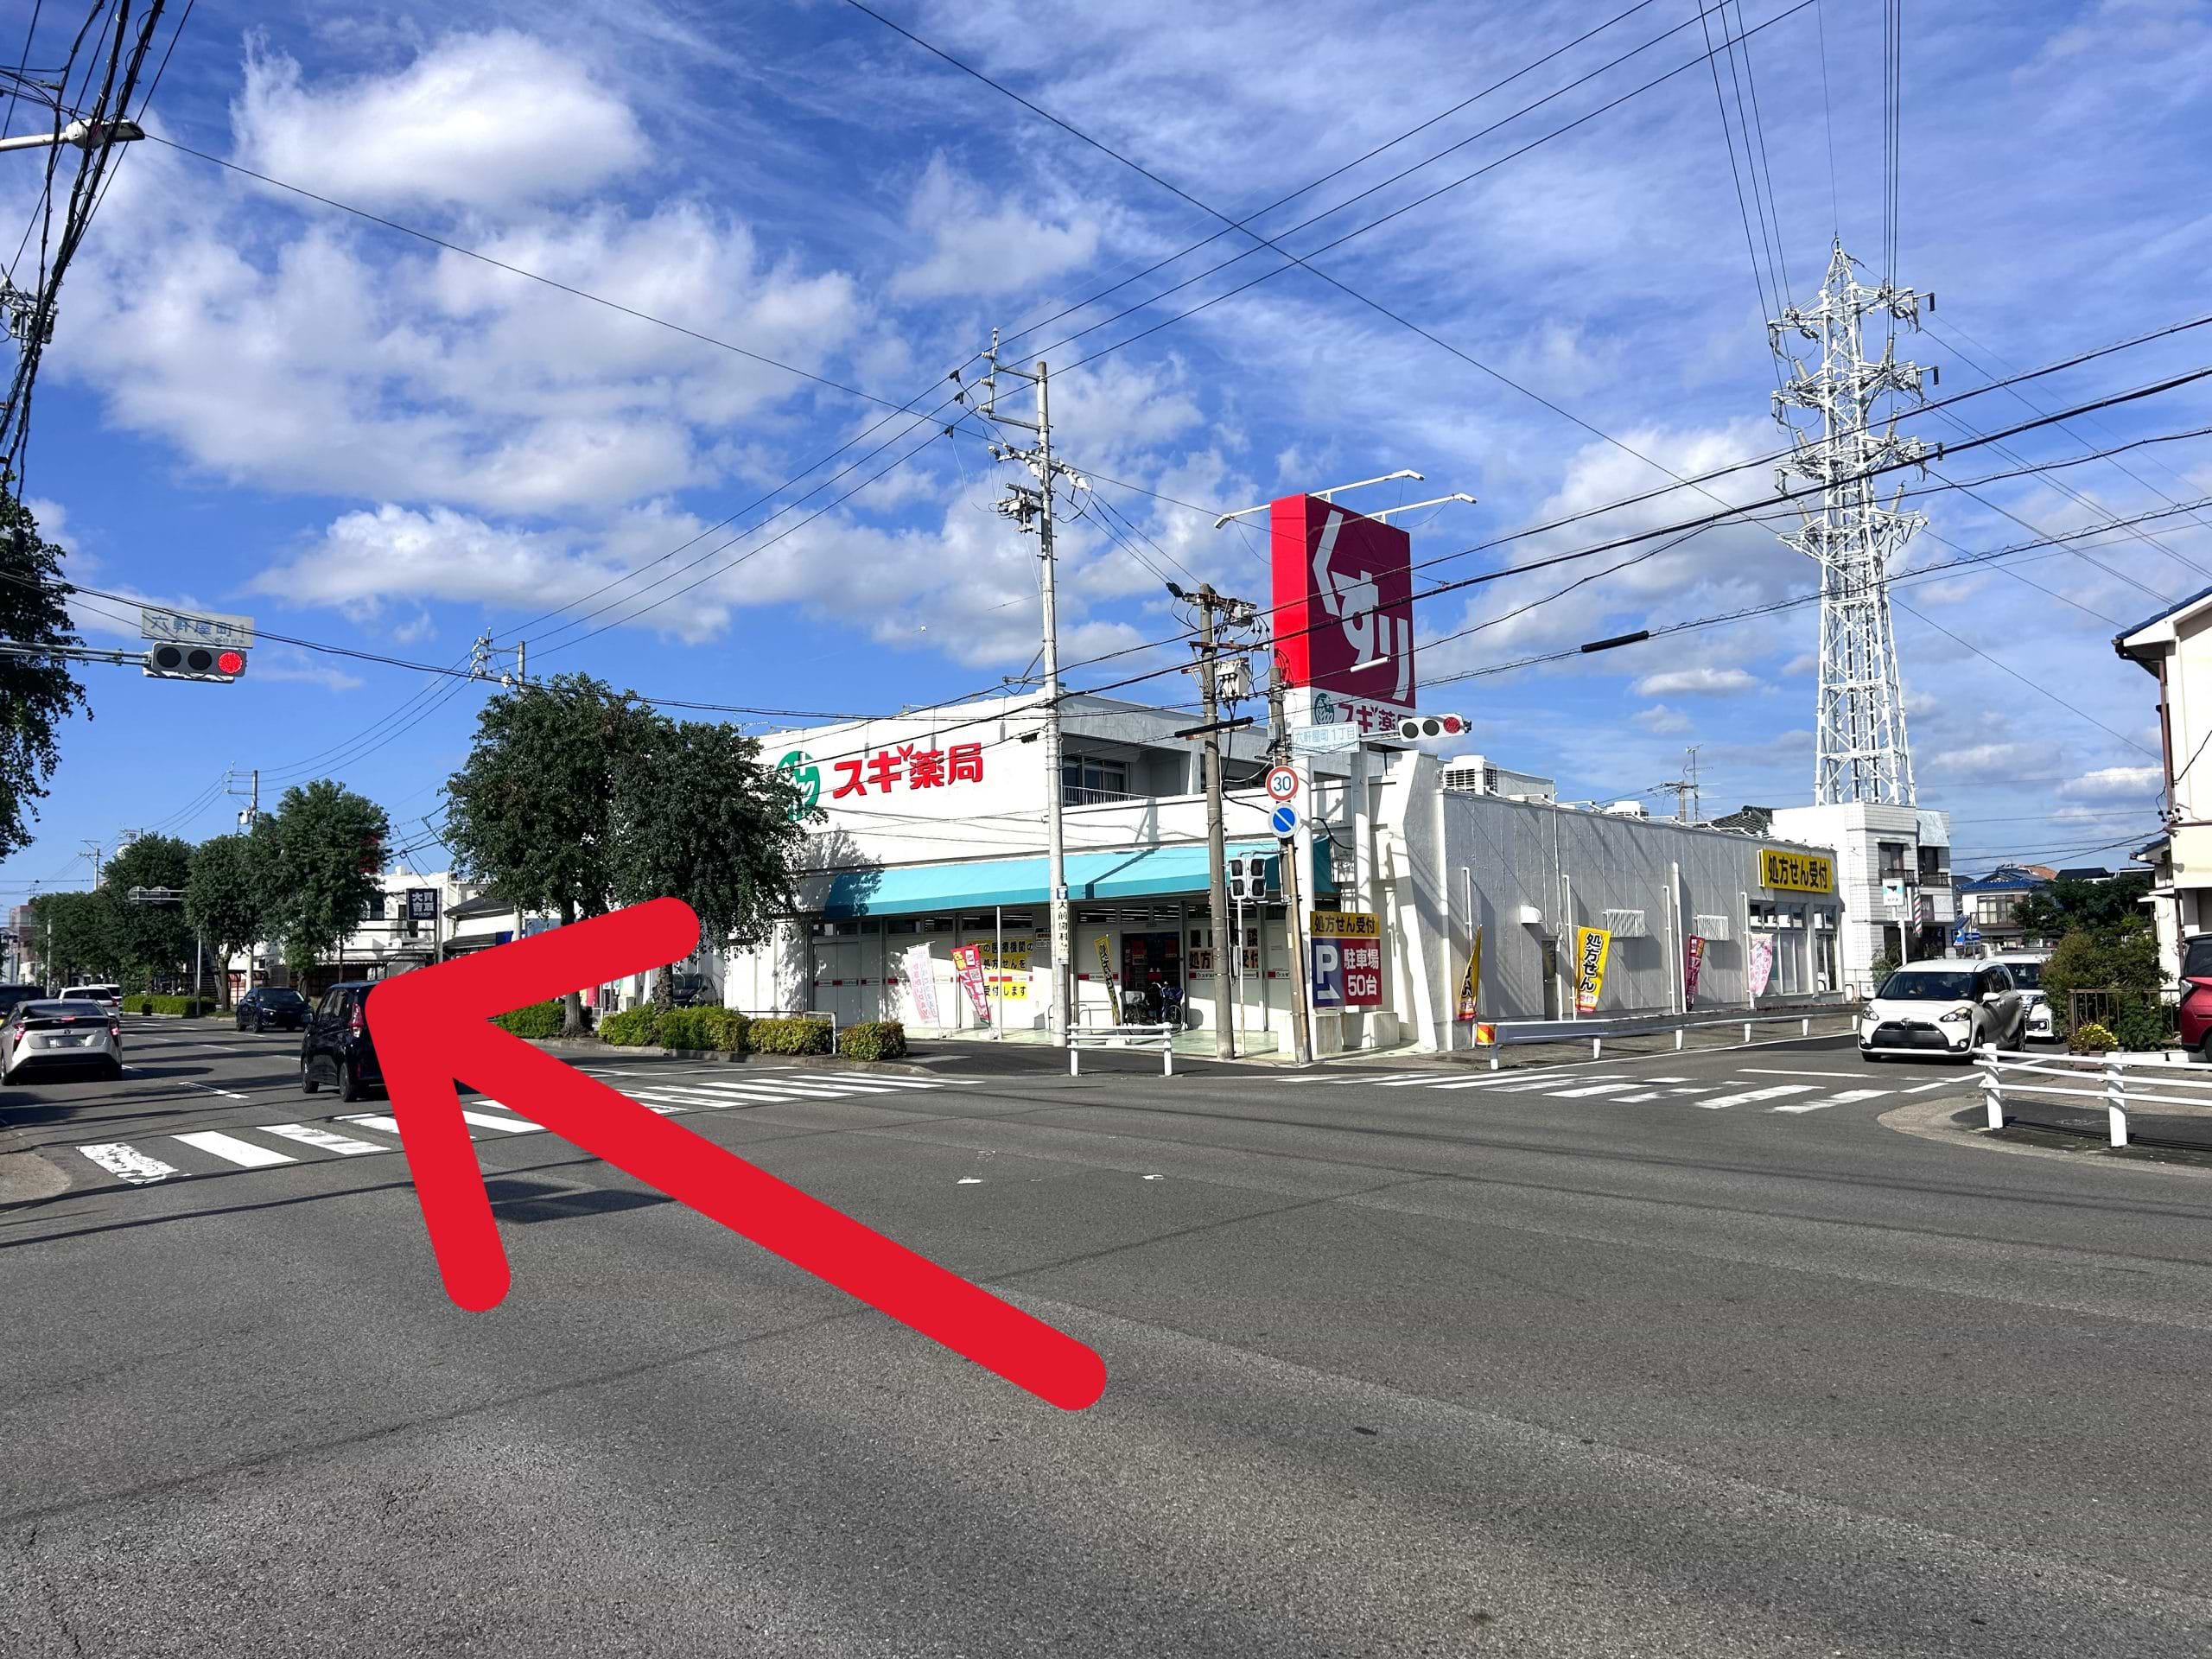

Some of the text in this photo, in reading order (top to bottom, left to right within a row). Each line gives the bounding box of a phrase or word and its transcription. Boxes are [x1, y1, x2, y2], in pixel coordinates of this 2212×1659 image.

[1312, 509, 1410, 702] くすり
[1338, 703, 1414, 734] スギ薬
[833, 743, 983, 798] スギ薬局
[1274, 775, 1292, 792] 30
[1769, 855, 1827, 889] 処方せん受付
[1314, 915, 1376, 934] 処方せん受付
[983, 958, 1026, 969] 処方せんを
[1316, 945, 1338, 984] P
[1344, 948, 1380, 969] 駐車場
[1580, 933, 1602, 991] 処方せん
[984, 985, 1027, 996] 受付します
[1347, 974, 1377, 996] 50台
